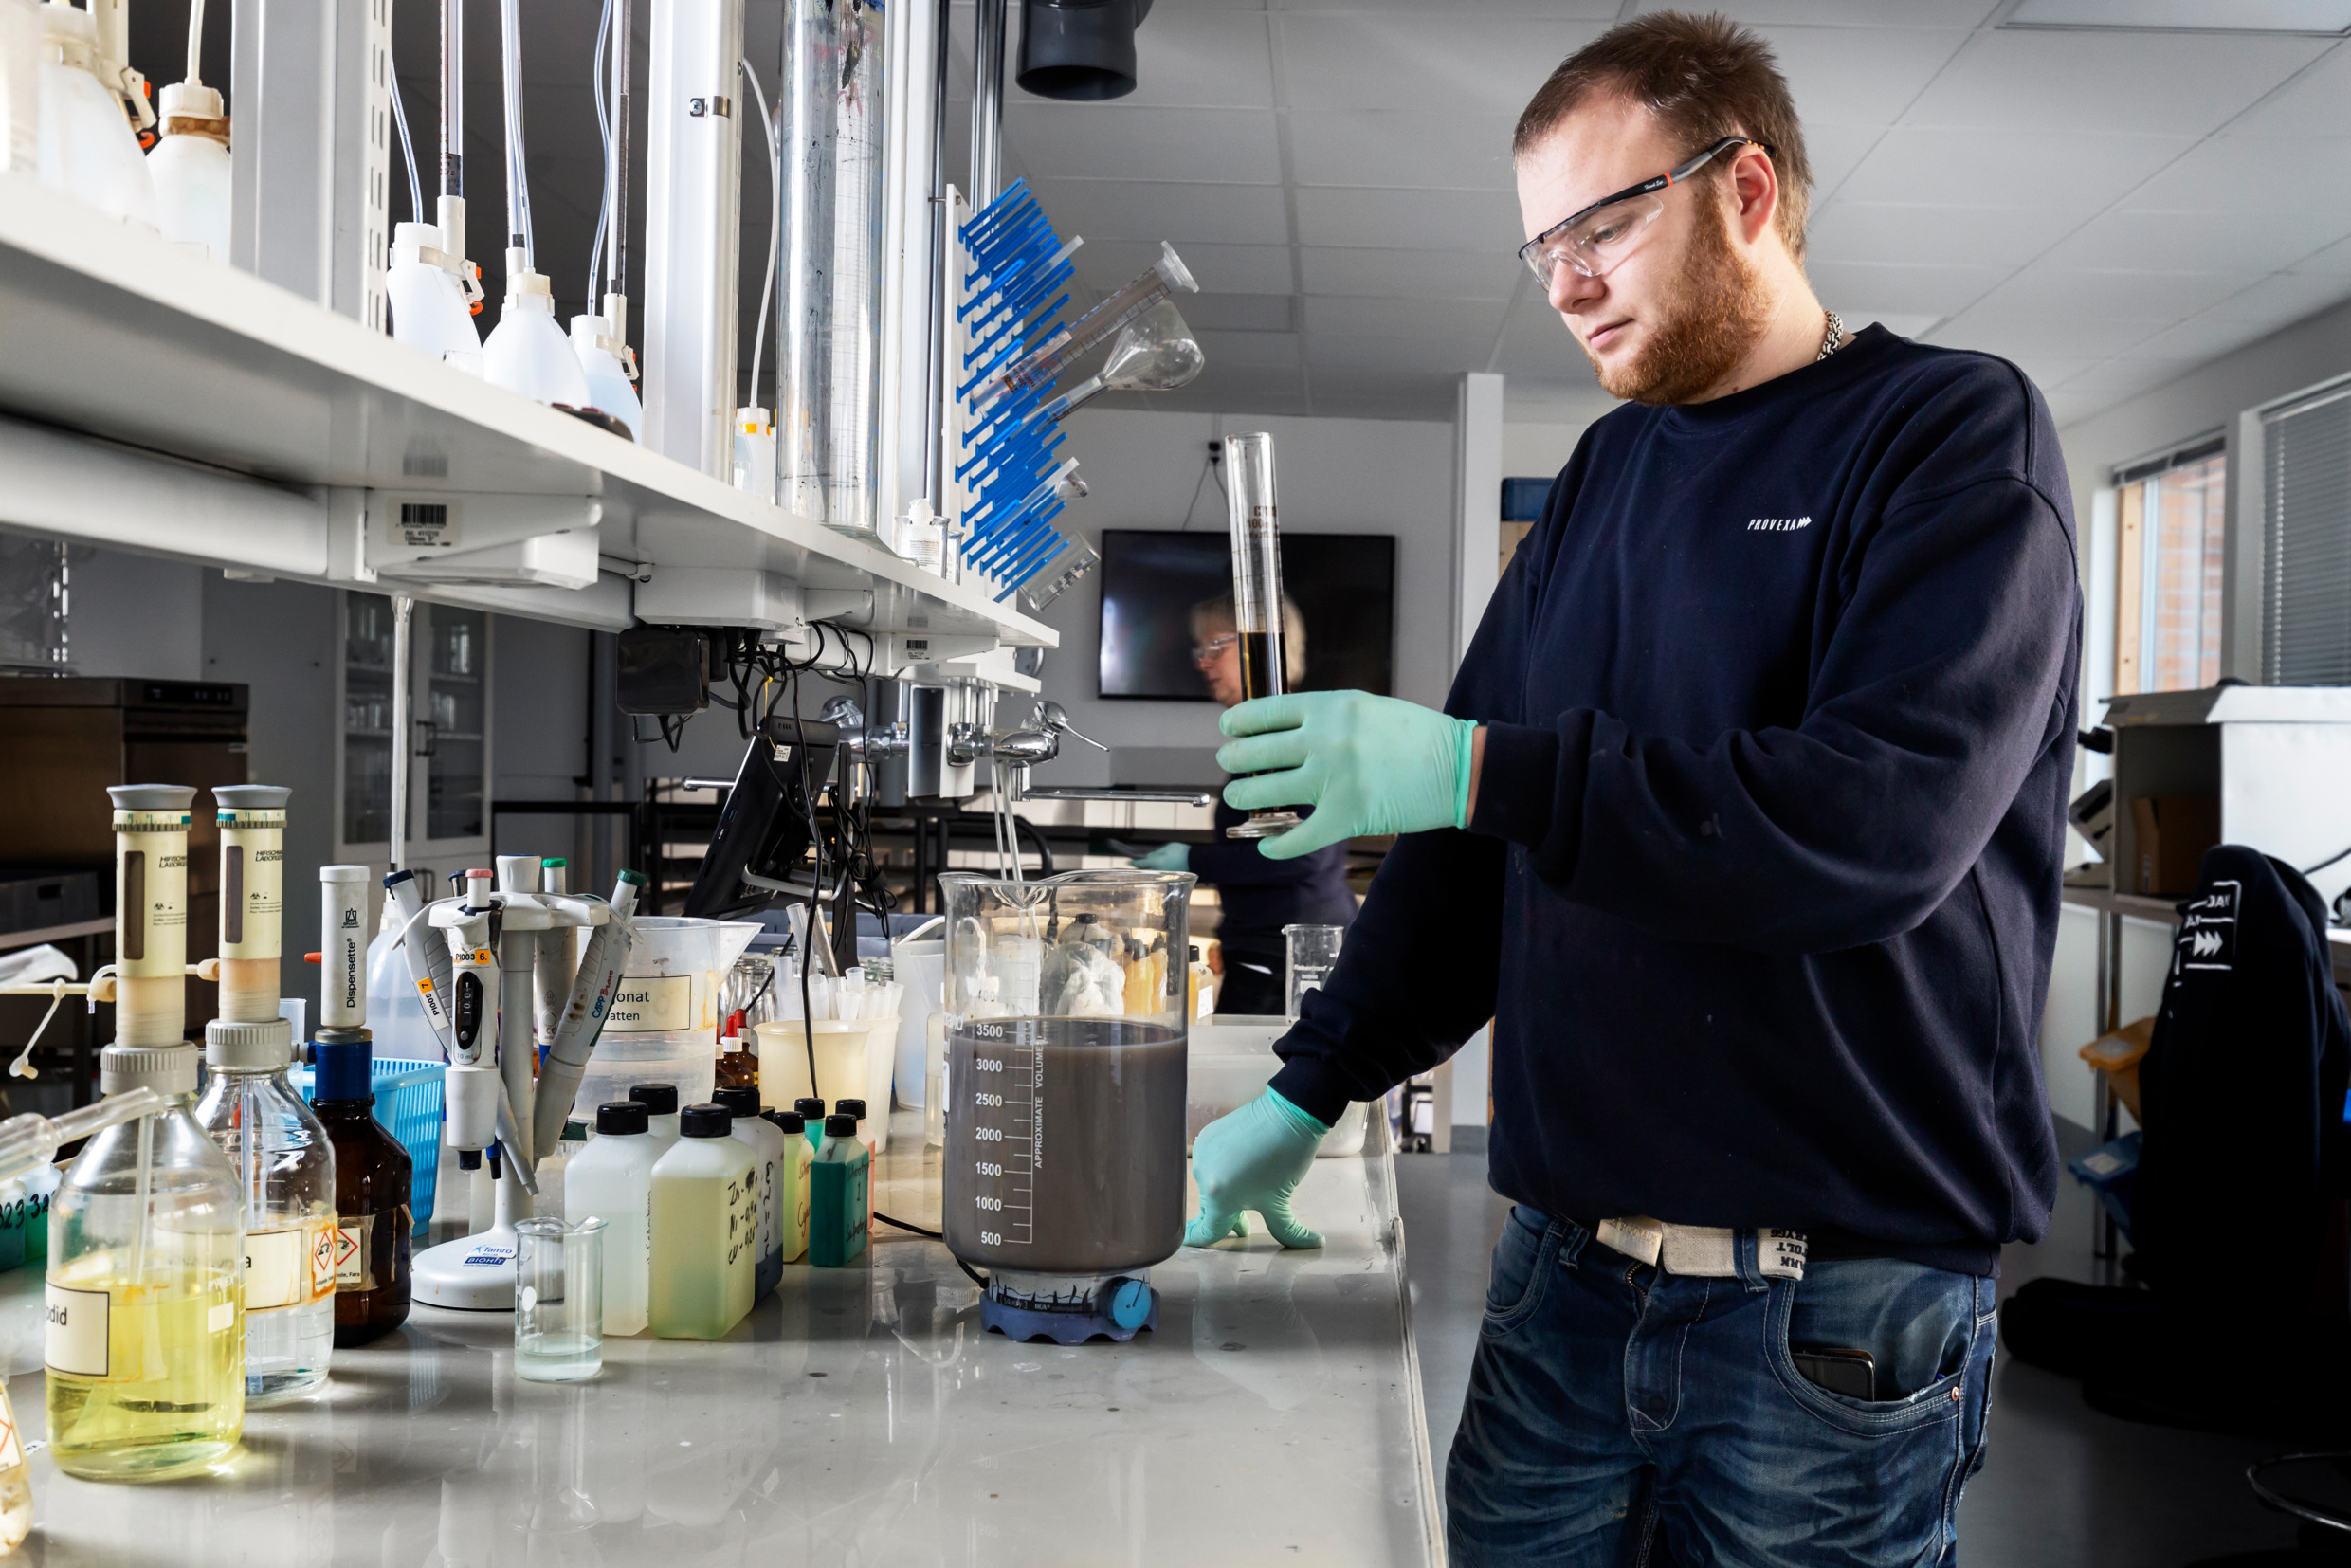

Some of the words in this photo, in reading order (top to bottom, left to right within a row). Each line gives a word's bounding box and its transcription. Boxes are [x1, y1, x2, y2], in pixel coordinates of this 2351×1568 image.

[1747, 518, 1797, 531] PROVEXA
[456, 953, 475, 961] PI003
[613, 991, 650, 1003] onat
[608, 1012, 640, 1021] atten
[976, 1024, 1004, 1038] 3500
[975, 1058, 1003, 1072] 3000
[1035, 1045, 1044, 1089] VOLUME
[975, 1092, 1003, 1107] 2500
[975, 1126, 1003, 1142] 2000
[1034, 1096, 1044, 1169] APPROXIMATE
[975, 1161, 1002, 1176] 1500
[975, 1195, 1002, 1212] 1000
[980, 1231, 1002, 1246] 500
